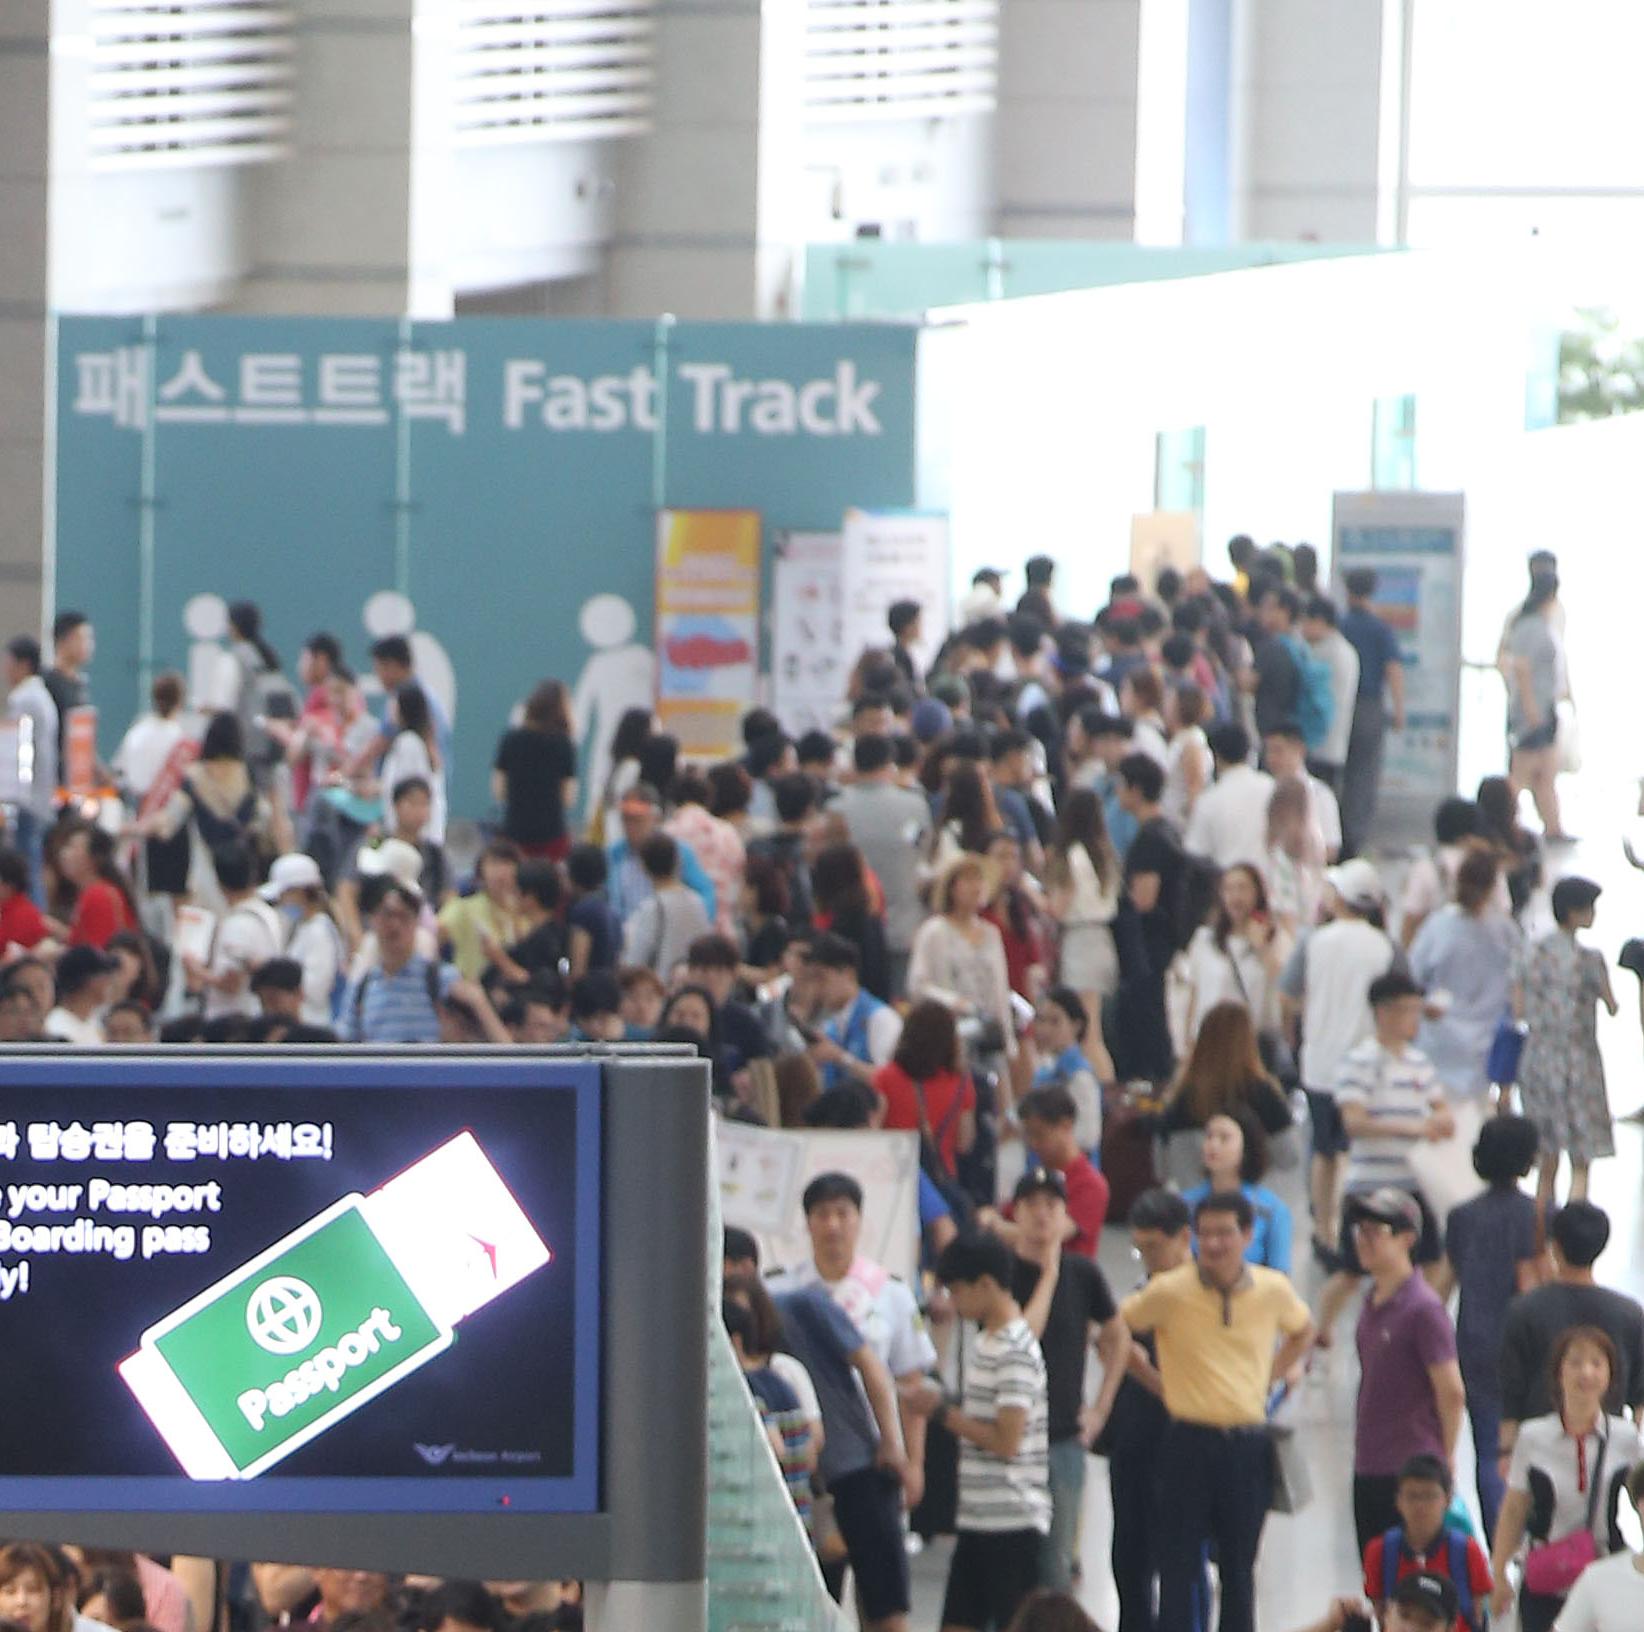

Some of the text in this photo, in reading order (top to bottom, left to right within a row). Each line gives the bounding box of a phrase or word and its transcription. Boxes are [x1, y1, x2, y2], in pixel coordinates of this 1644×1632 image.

[74, 348, 881, 435] 패스트트랙 Fast Track
[27, 1121, 156, 1161] 탑승권을
[164, 1121, 334, 1161] 준비하세요!
[7, 1183, 83, 1218] your
[88, 1177, 222, 1218] Passport
[141, 1224, 211, 1259] pass
[237, 1307, 402, 1431] Passport
